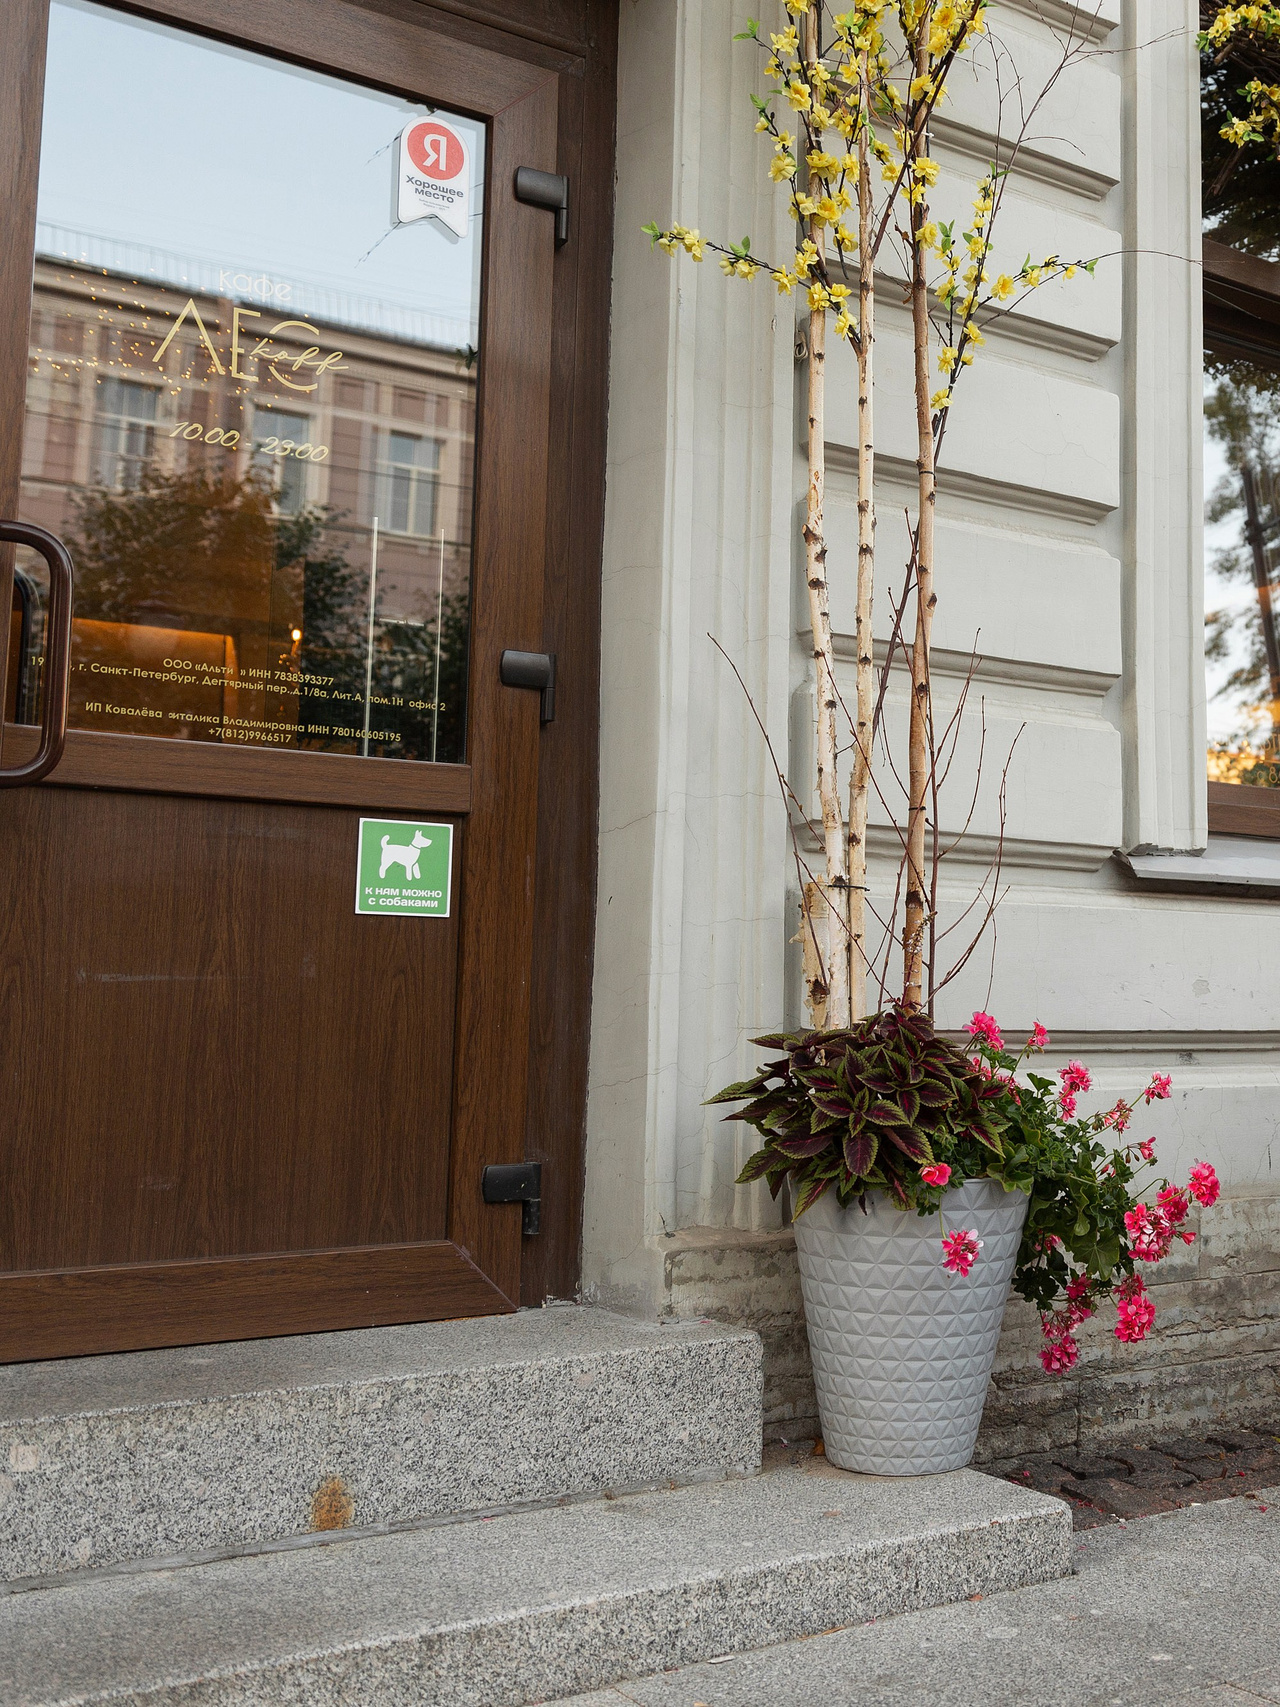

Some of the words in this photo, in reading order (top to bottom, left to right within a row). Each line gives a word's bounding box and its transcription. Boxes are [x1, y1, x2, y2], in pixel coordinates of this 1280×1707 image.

[422, 133, 447, 171] Я
[406, 174, 464, 198] Хорошее
[414, 187, 454, 203] место
[219, 268, 292, 302] кафе
[169, 421, 240, 447] 10.00
[260, 436, 329, 462] 23.00
[90, 663, 199, 685] Санкт-Петербург,
[440, 702, 446, 711] 2
[163, 658, 192, 670] ООО
[248, 668, 271, 679] ИНН
[274, 671, 334, 686] 7838393377
[85, 701, 102, 713] ИП
[105, 704, 163, 718] Ковалёва
[222, 715, 305, 732] Владимировна
[307, 724, 329, 735] ИНН
[208, 727, 291, 743] +7(812)9966517
[379, 897, 439, 908] собаками
